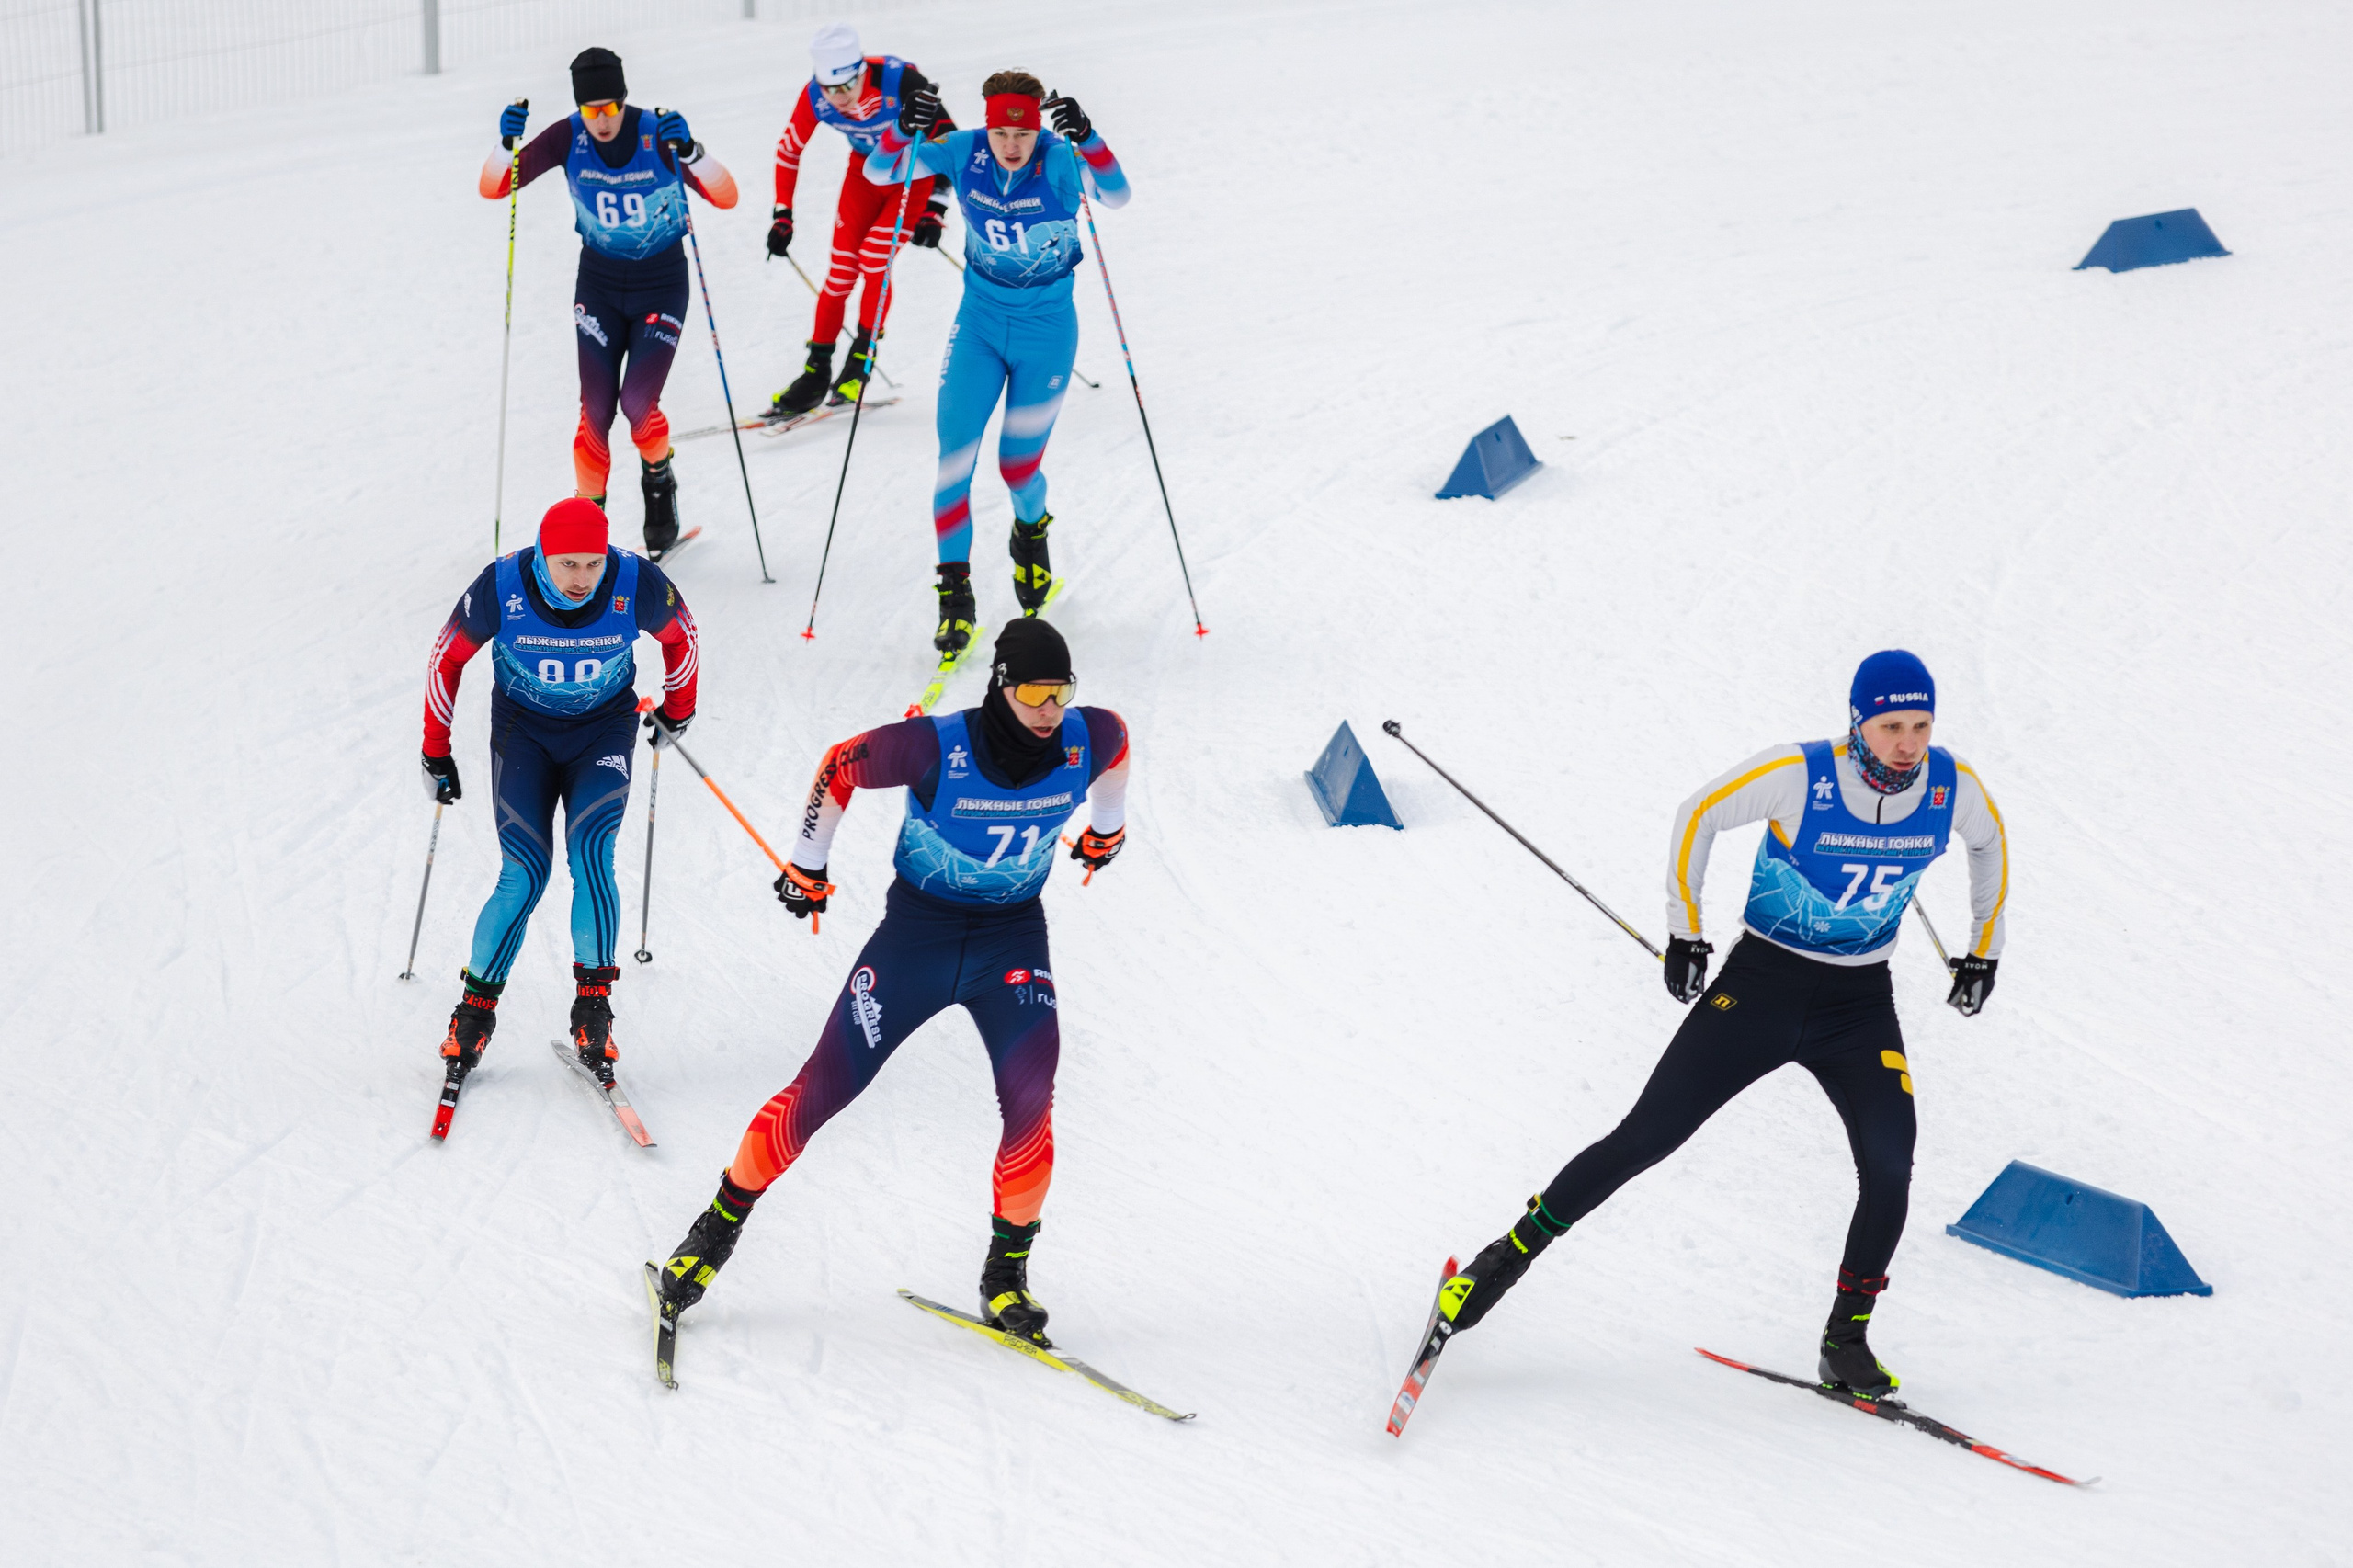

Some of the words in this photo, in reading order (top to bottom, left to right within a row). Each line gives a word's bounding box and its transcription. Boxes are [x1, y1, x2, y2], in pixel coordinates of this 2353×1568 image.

[596, 190, 647, 228] 69
[970, 189, 1008, 212] ЛЫЖНЕ
[984, 218, 1029, 254] 61
[517, 637, 575, 647] ЛЫЖНЫЕ
[580, 635, 622, 647] ГОНКИ
[1889, 692, 1929, 704] RUSSIA
[958, 799, 1023, 811] ЛЫЖНЫЕ
[1027, 793, 1071, 809] ГОНКИ
[984, 824, 1040, 868] 71
[1820, 834, 1885, 849] ЛЫЖНЫЕ
[1889, 837, 1933, 849] ГОНКИ
[1834, 863, 1904, 911] 75
[860, 973, 882, 1043] PROGRESS
[1004, 1335, 1038, 1355] FISCHER
